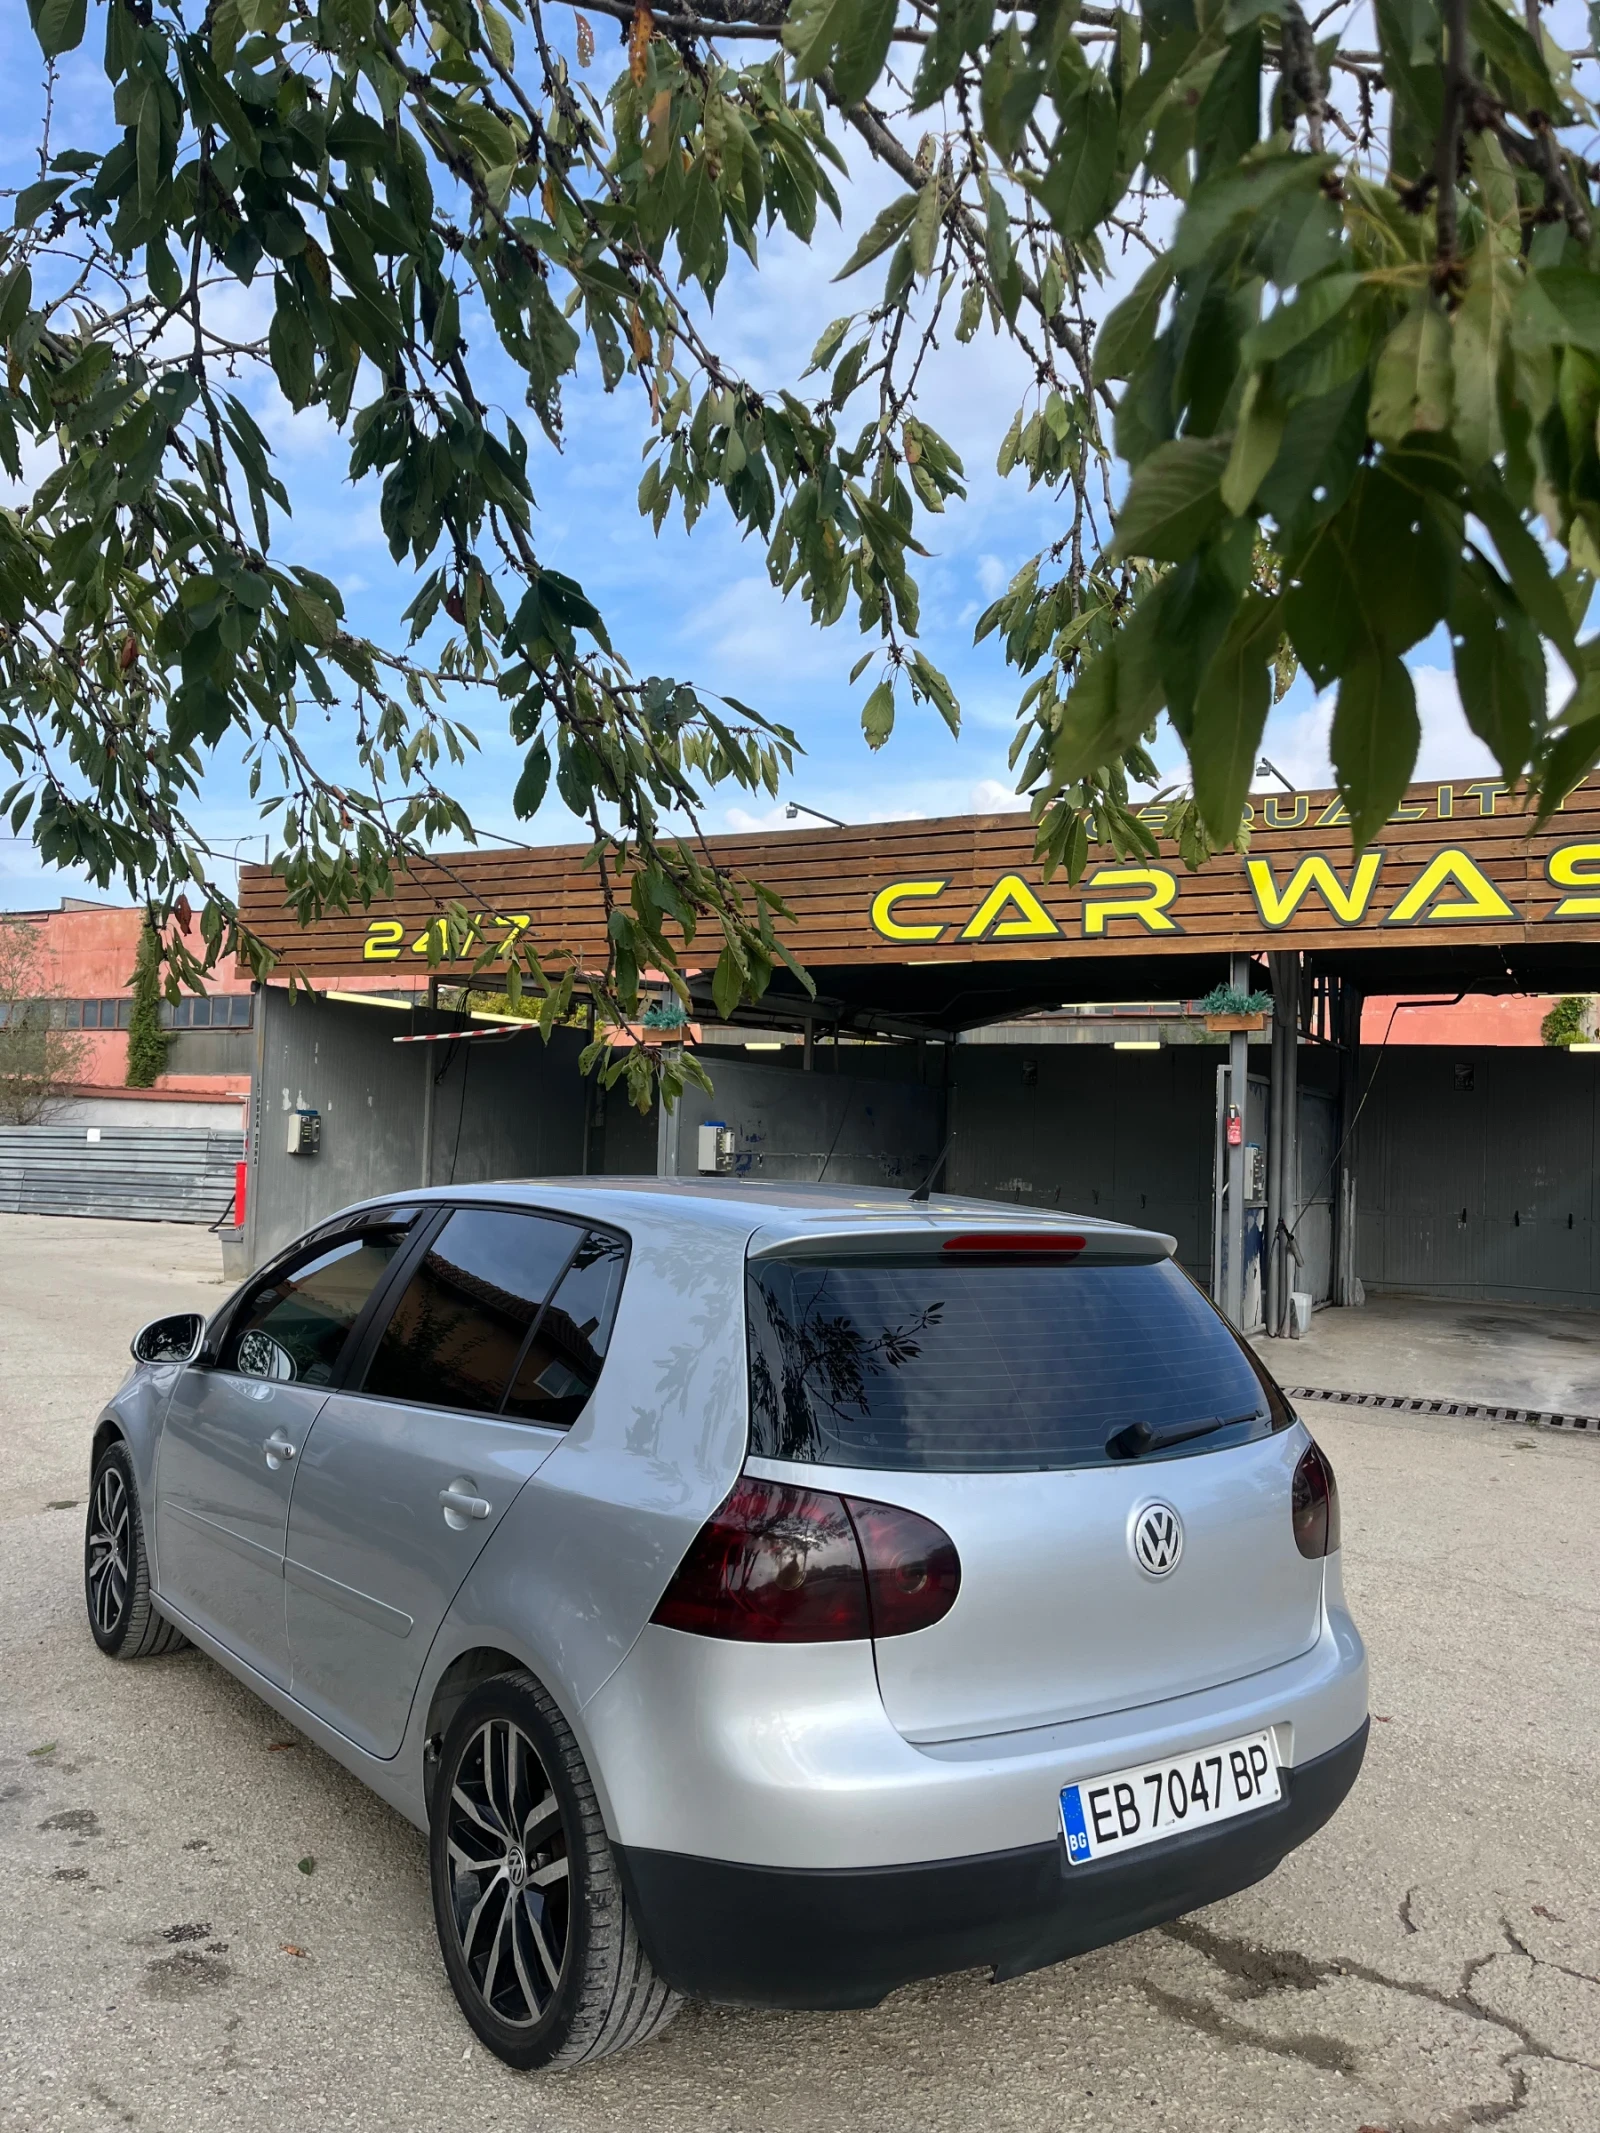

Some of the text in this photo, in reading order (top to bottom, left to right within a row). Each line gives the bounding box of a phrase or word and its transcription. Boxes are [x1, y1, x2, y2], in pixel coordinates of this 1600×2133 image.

[868, 865, 1187, 943] CAR
[363, 912, 532, 961] 24/7
[1088, 1744, 1268, 1844] EB 7047 BP
[1069, 1833, 1088, 1852] BG
